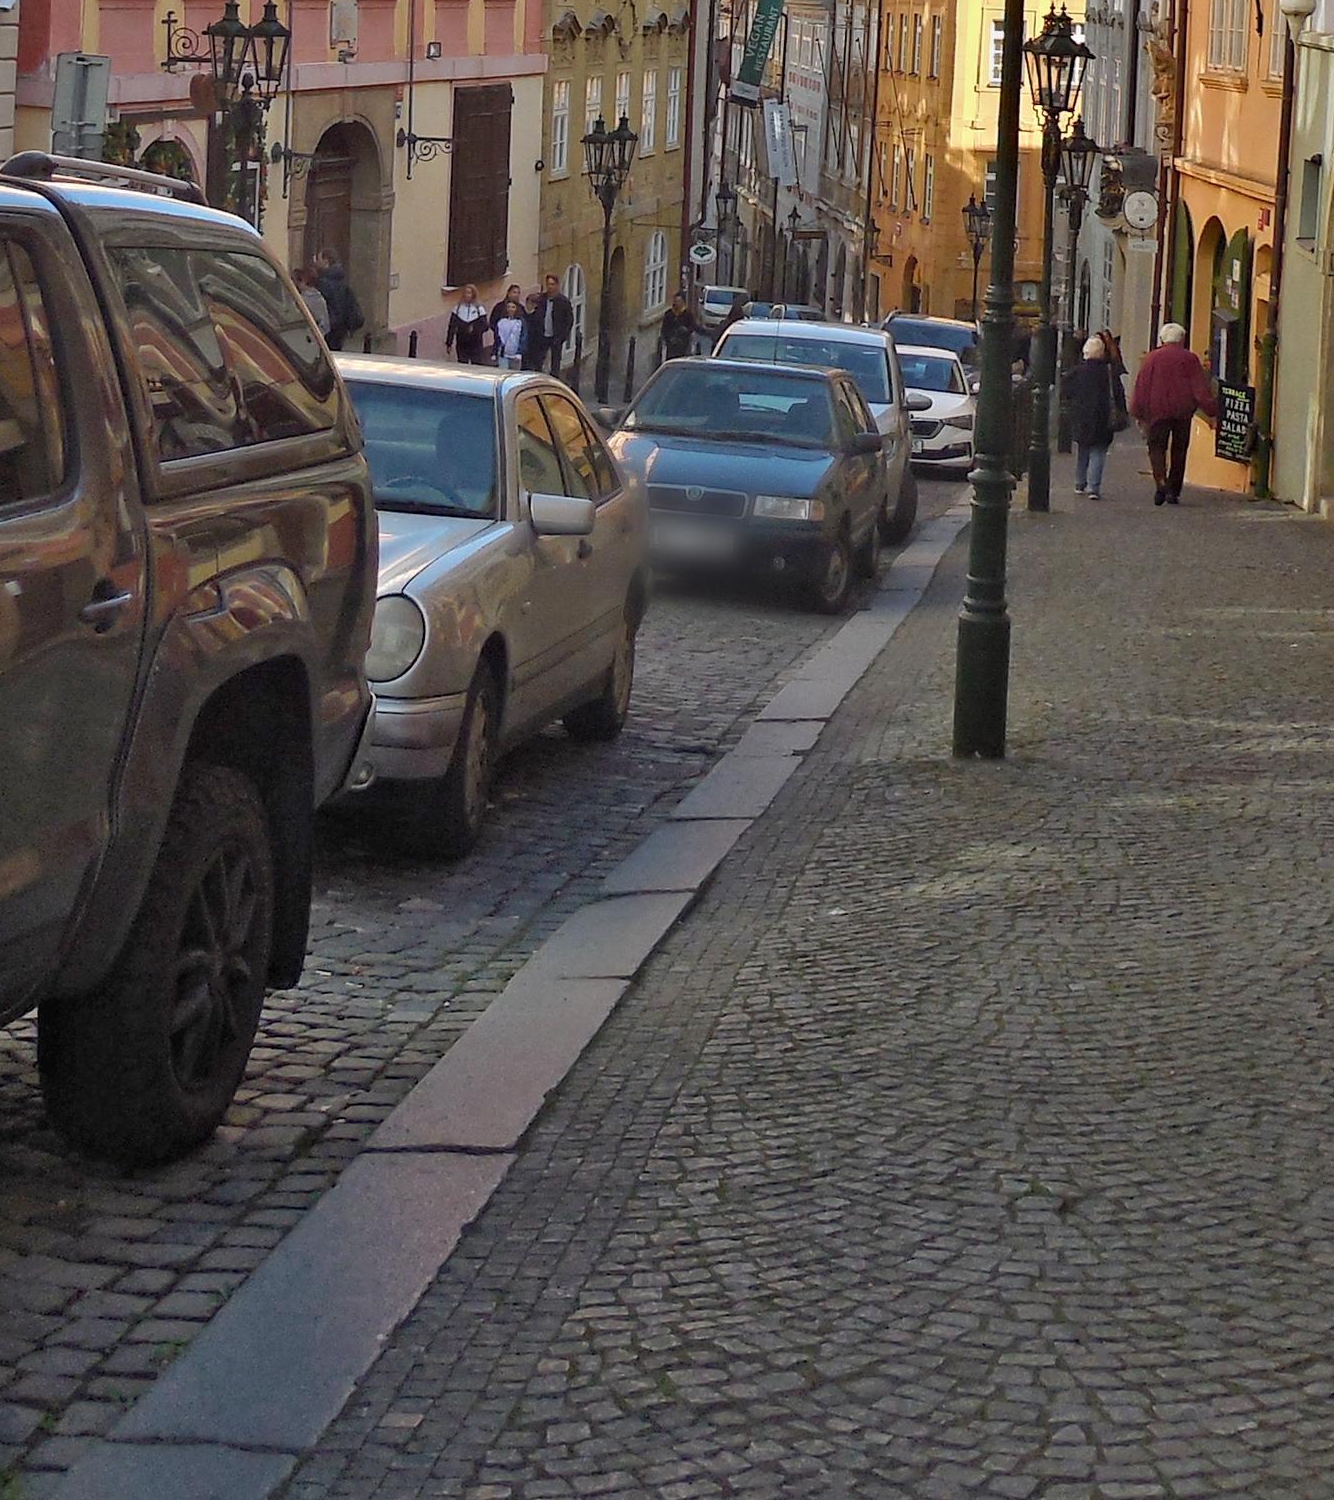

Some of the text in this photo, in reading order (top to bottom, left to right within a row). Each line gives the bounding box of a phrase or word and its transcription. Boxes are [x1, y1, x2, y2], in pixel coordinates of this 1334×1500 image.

[745, 13, 766, 57] VEGAN
[754, 6, 780, 72] RESTAURANT
[1225, 397, 1251, 413] PIZZA
[1226, 409, 1249, 424] PASTA
